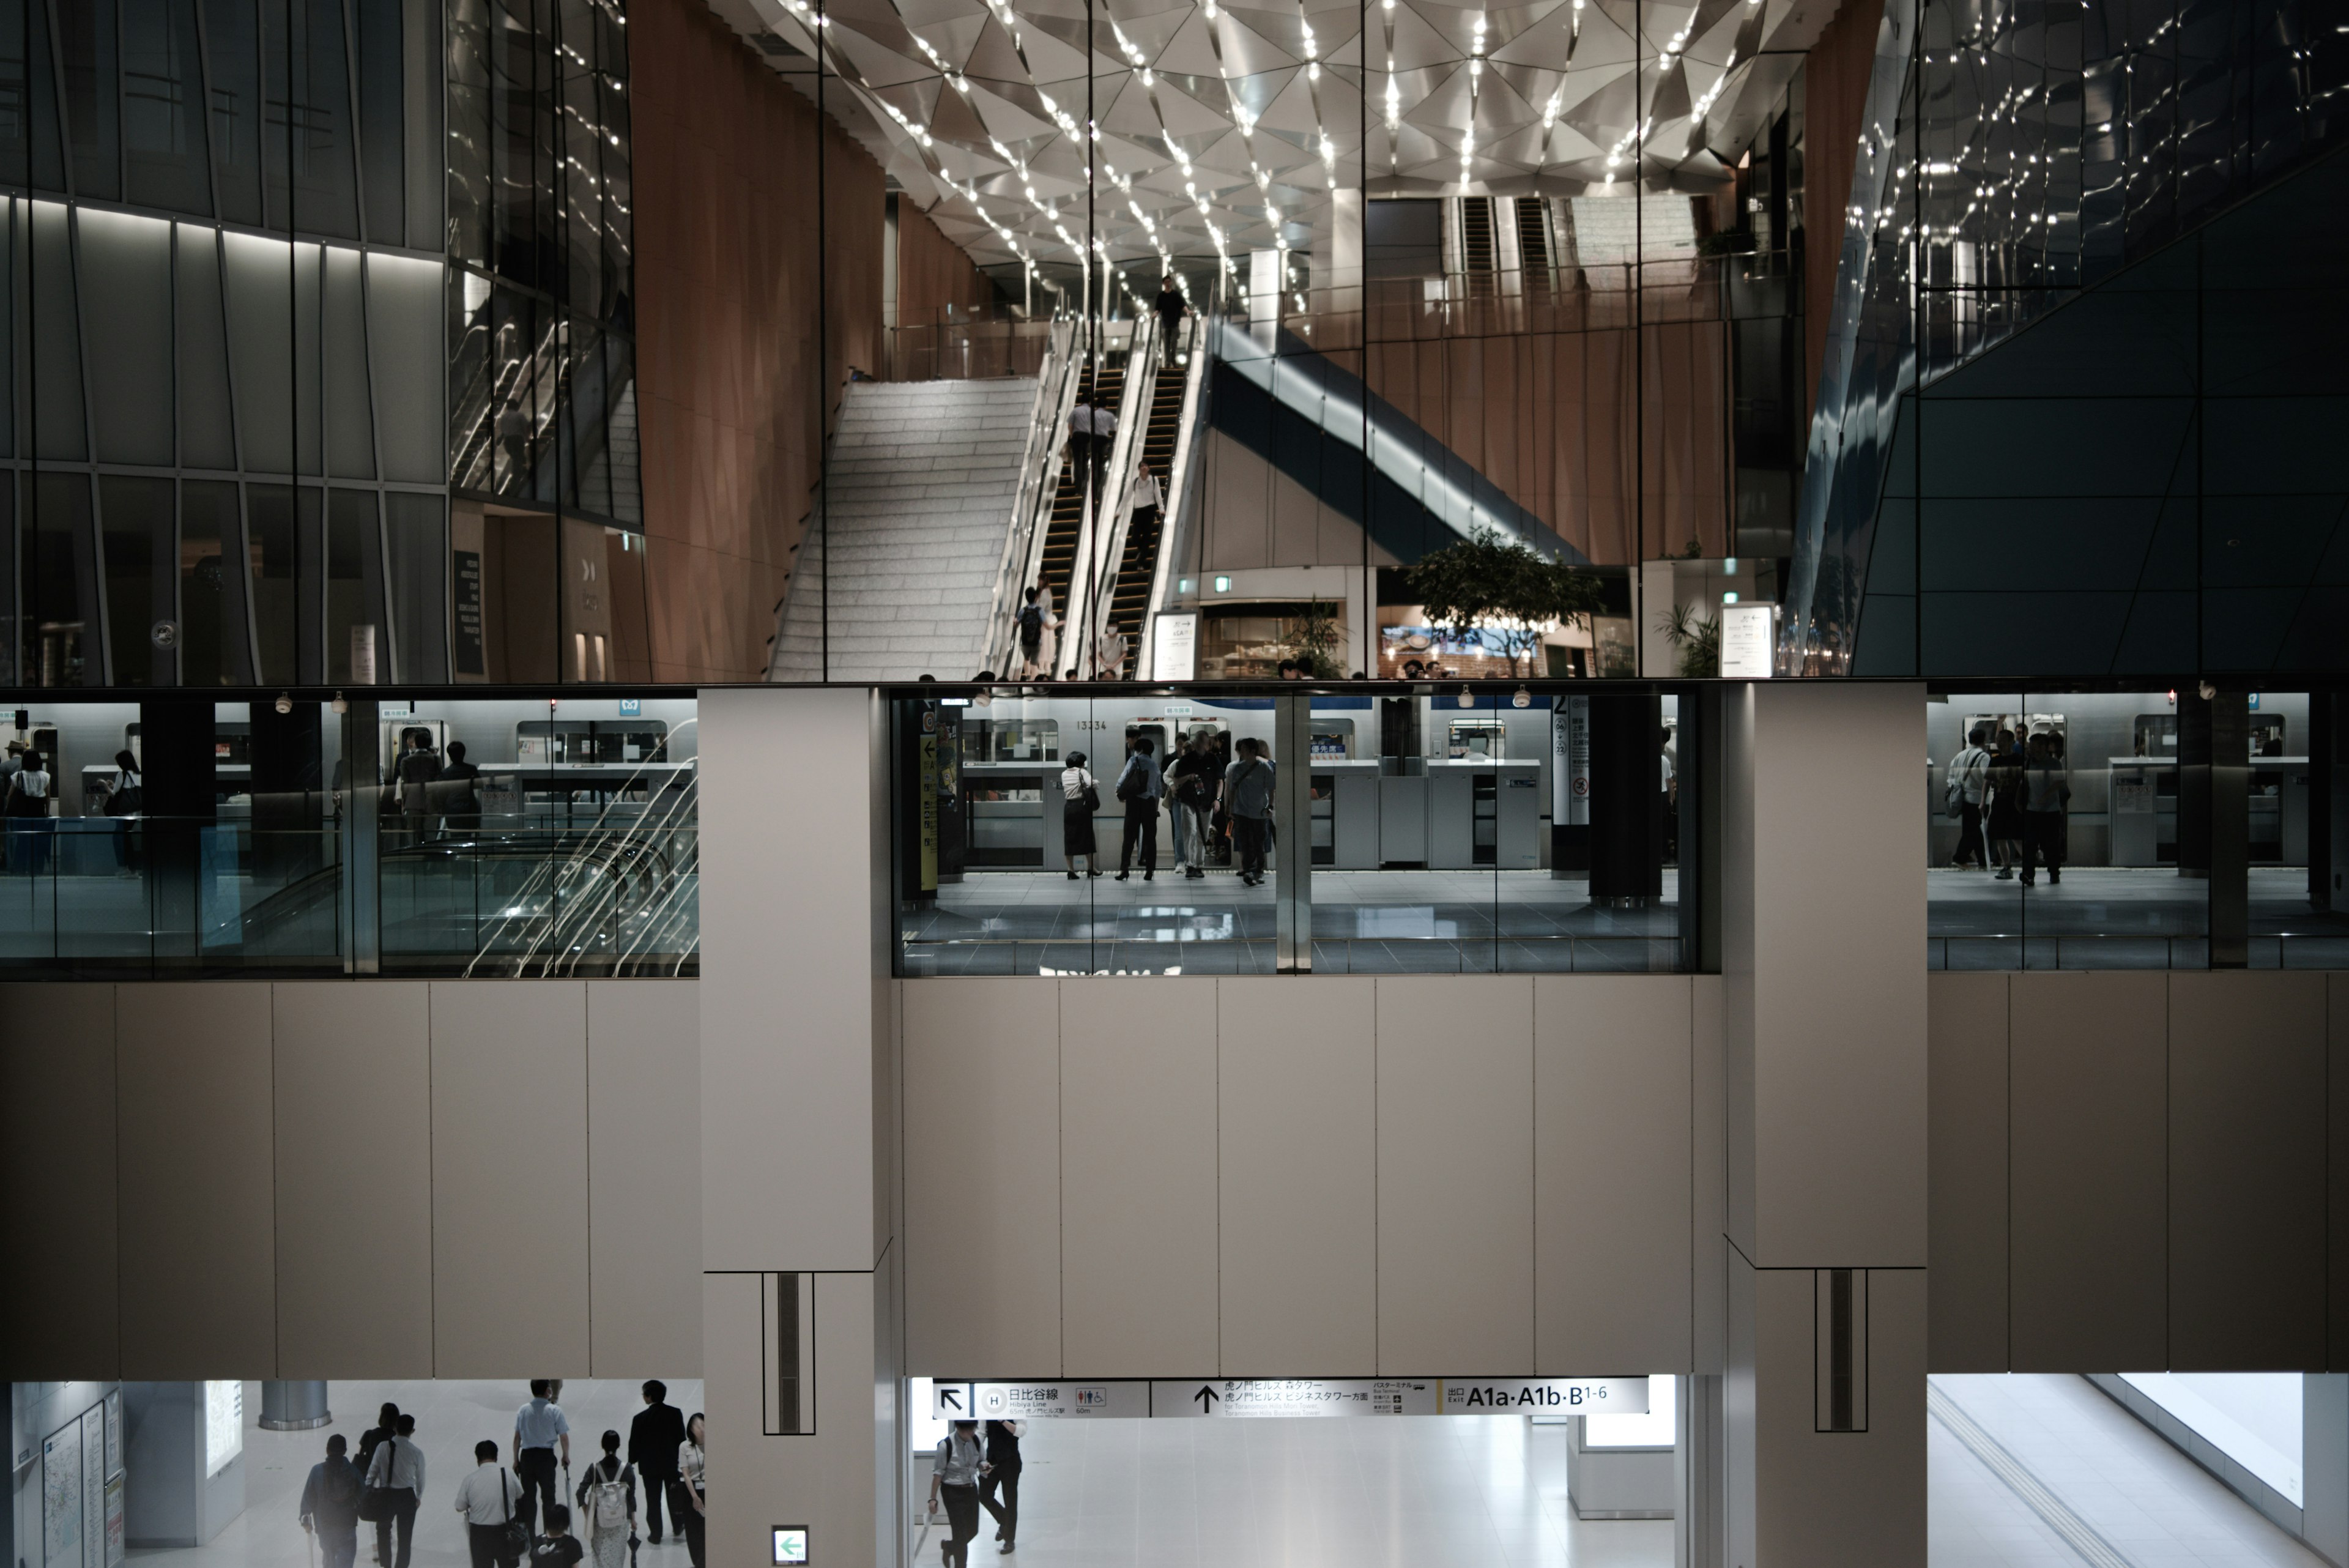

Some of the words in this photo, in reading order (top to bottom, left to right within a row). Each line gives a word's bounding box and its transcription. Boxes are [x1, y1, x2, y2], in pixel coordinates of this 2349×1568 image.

[1554, 696, 1567, 714] 2
[1009, 1388, 1059, 1400] 日比谷線
[1286, 1392, 1368, 1401] ビジネスタワー方面
